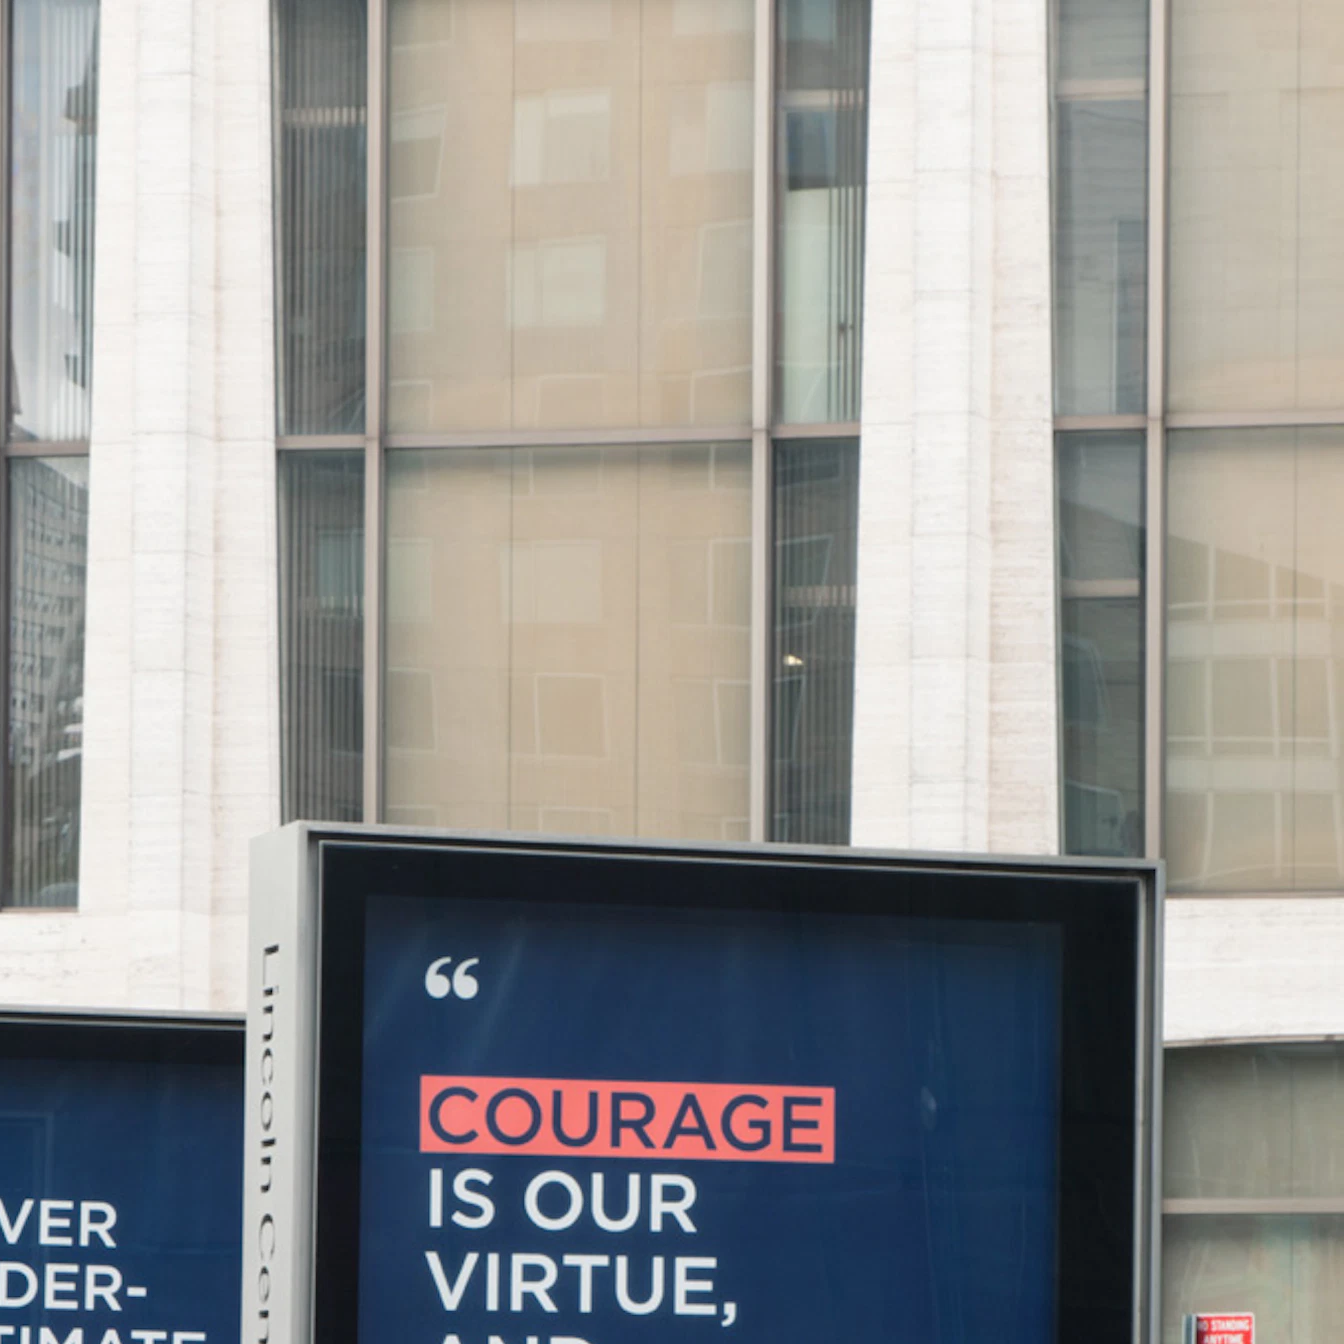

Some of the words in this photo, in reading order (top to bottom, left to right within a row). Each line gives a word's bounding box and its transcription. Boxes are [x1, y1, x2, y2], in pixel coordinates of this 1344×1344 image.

[261, 945, 280, 1195] Lincoln
[427, 1087, 824, 1154] COURAGE
[429, 1168, 494, 1230] IS
[524, 1170, 697, 1233] OUR
[425, 1251, 737, 1327] VIRTUE,
[1204, 1334, 1244, 1344] ANYTIME
[1211, 1320, 1250, 1331] STANDING
